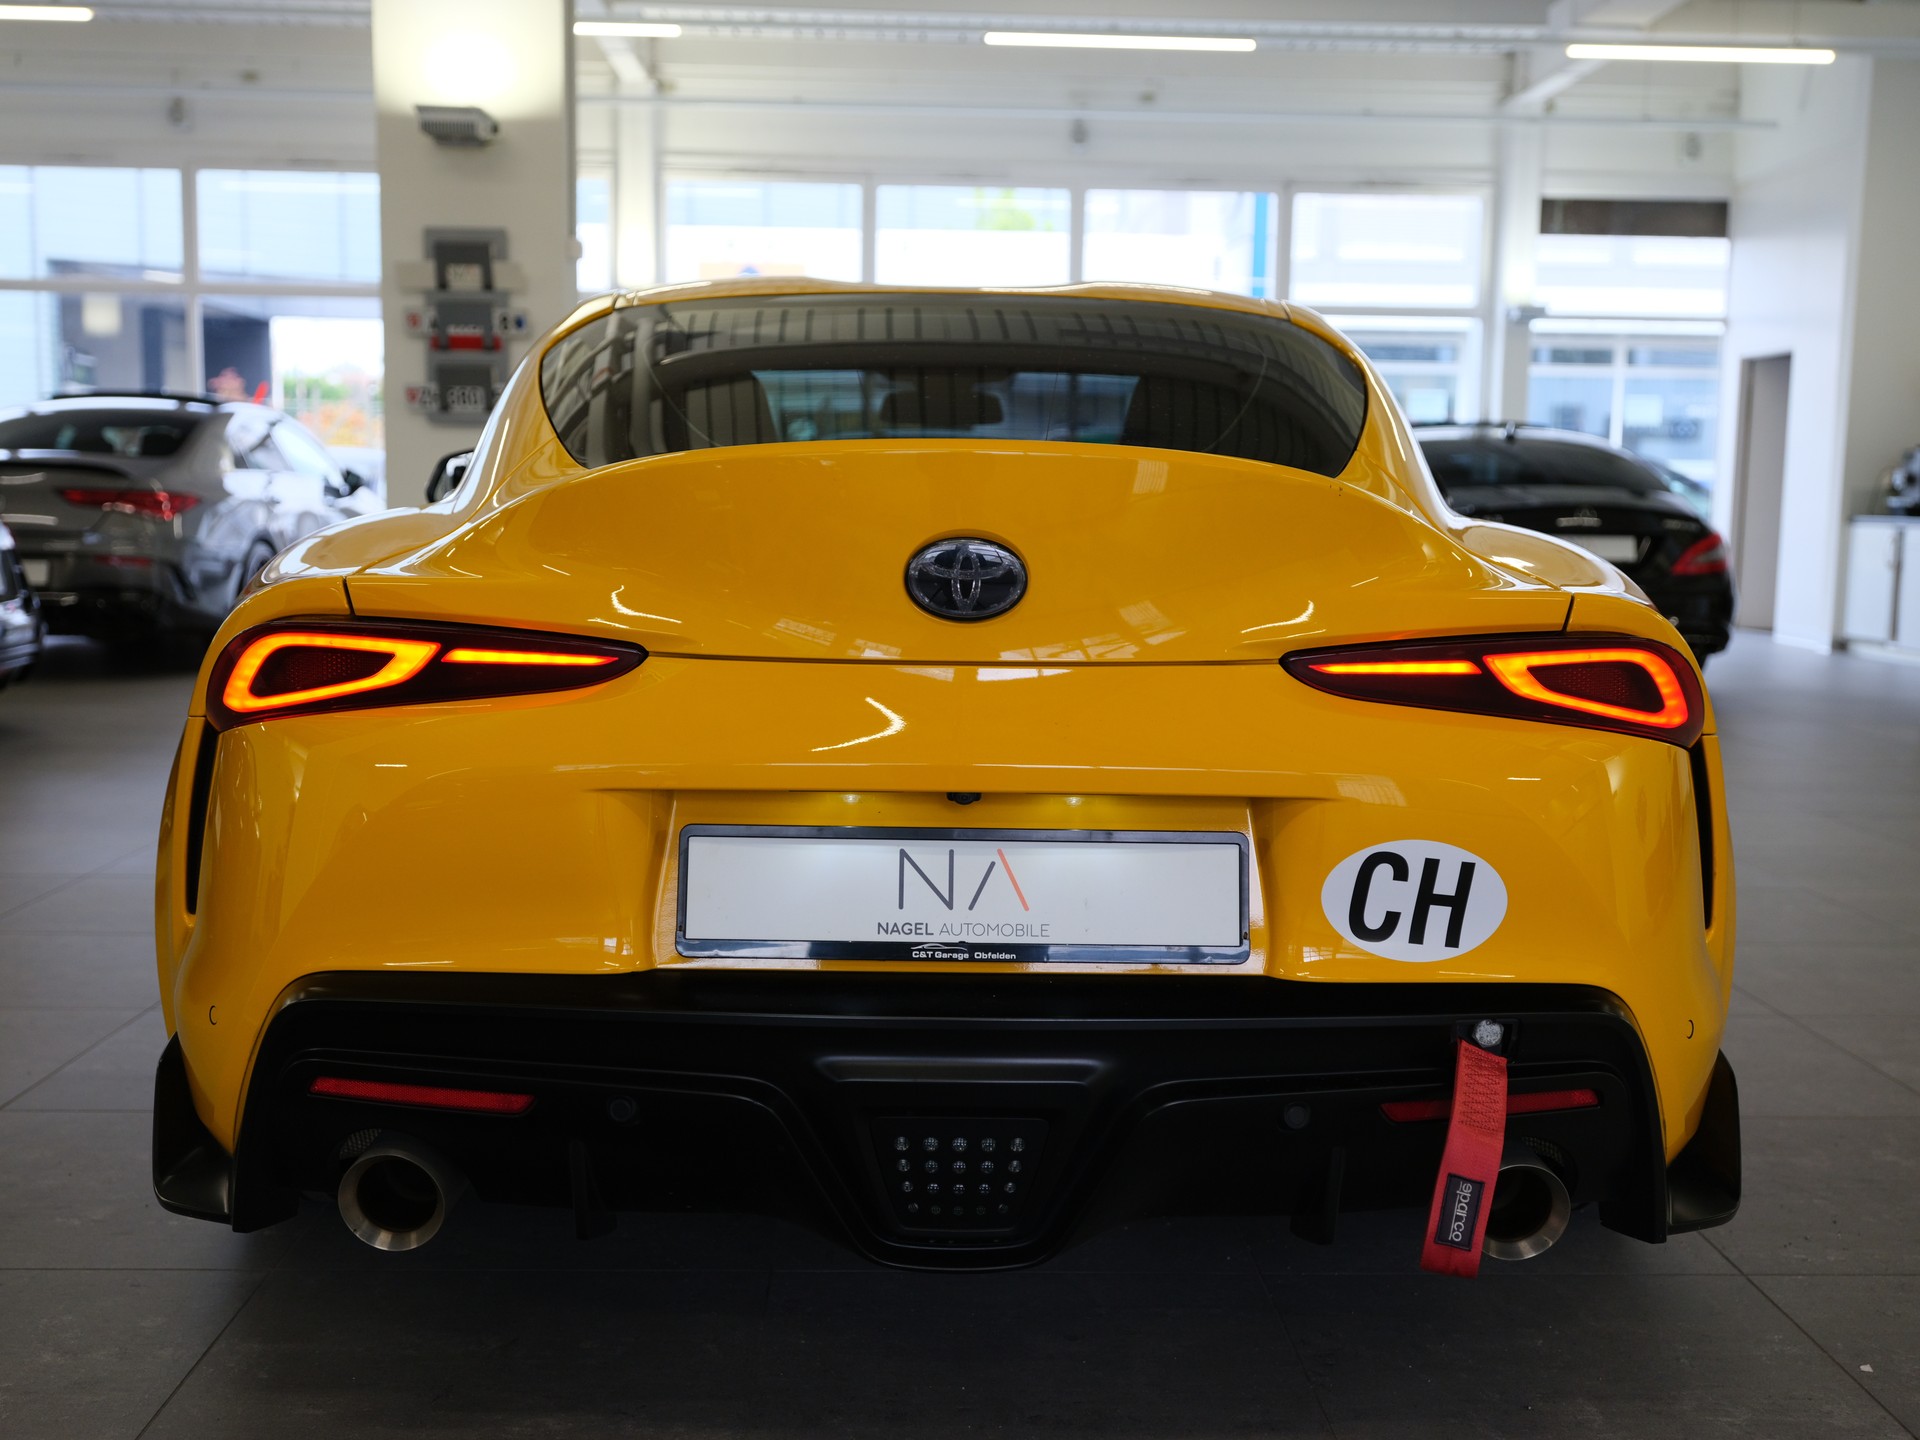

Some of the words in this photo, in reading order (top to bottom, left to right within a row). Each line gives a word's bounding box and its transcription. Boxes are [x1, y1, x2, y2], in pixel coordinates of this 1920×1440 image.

[1348, 850, 1476, 949] CH
[877, 922, 934, 936] NAGEL
[939, 923, 1050, 938] AUTOMOBILE
[911, 951, 933, 959] C&T
[934, 951, 970, 961] Garage
[974, 951, 1017, 960] Obfelden
[1452, 1183, 1473, 1242] sparco
